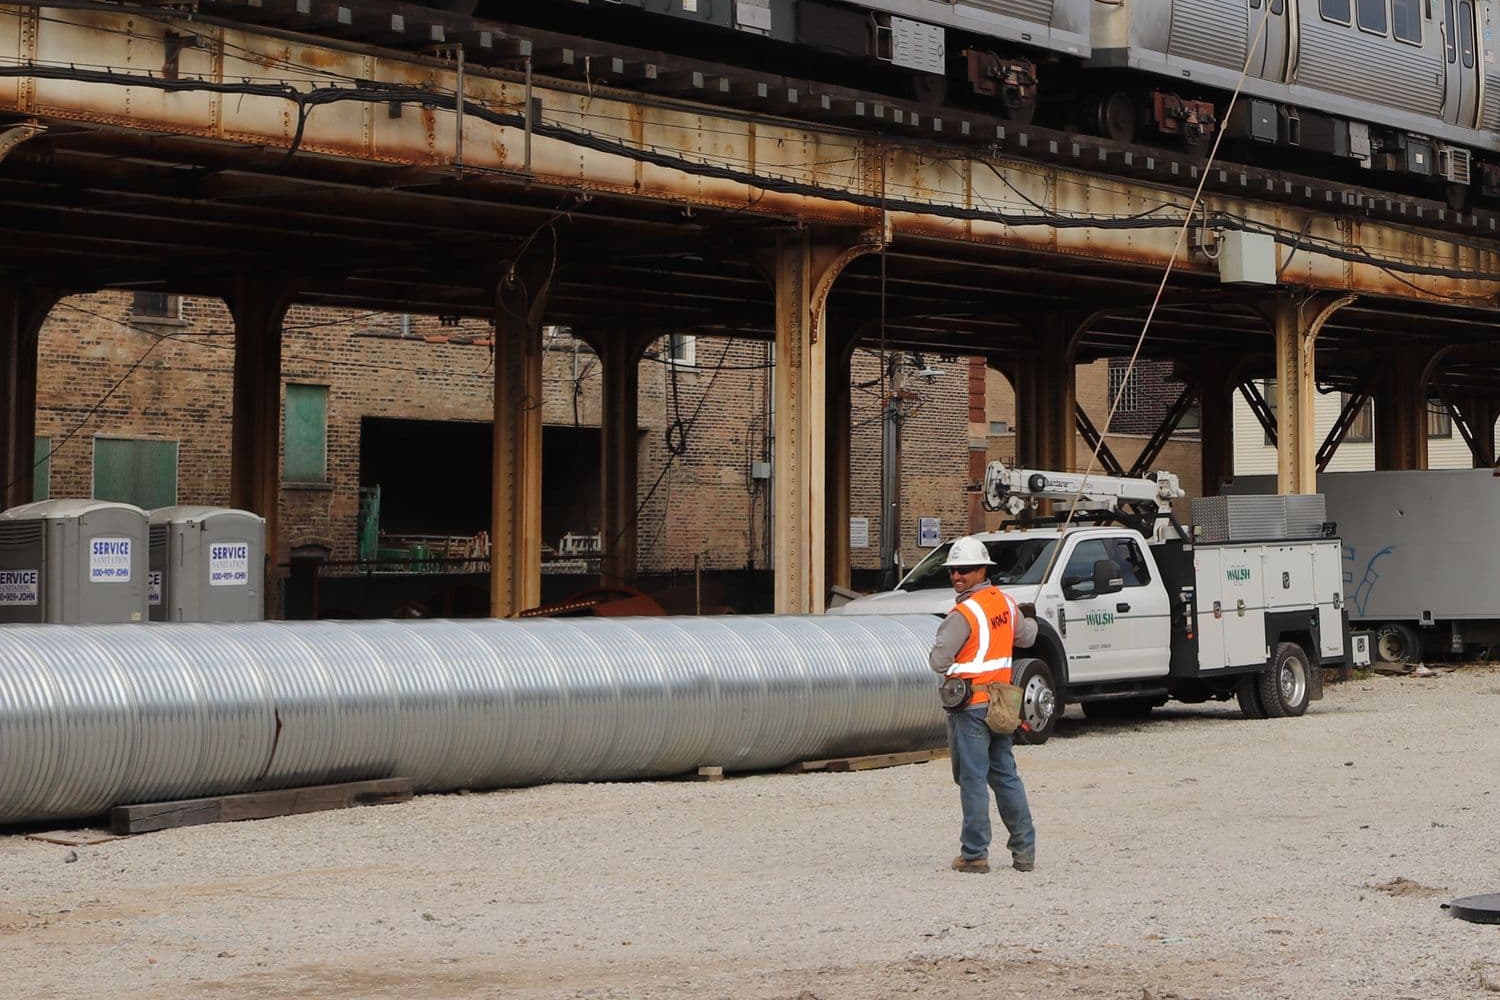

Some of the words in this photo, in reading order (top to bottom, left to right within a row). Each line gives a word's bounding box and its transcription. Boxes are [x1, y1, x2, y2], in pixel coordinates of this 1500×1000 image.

[93, 542, 129, 555] SERVICE
[212, 546, 246, 560] SERVICE
[1226, 568, 1251, 581] WALSH
[1085, 612, 1115, 626] WALSH
